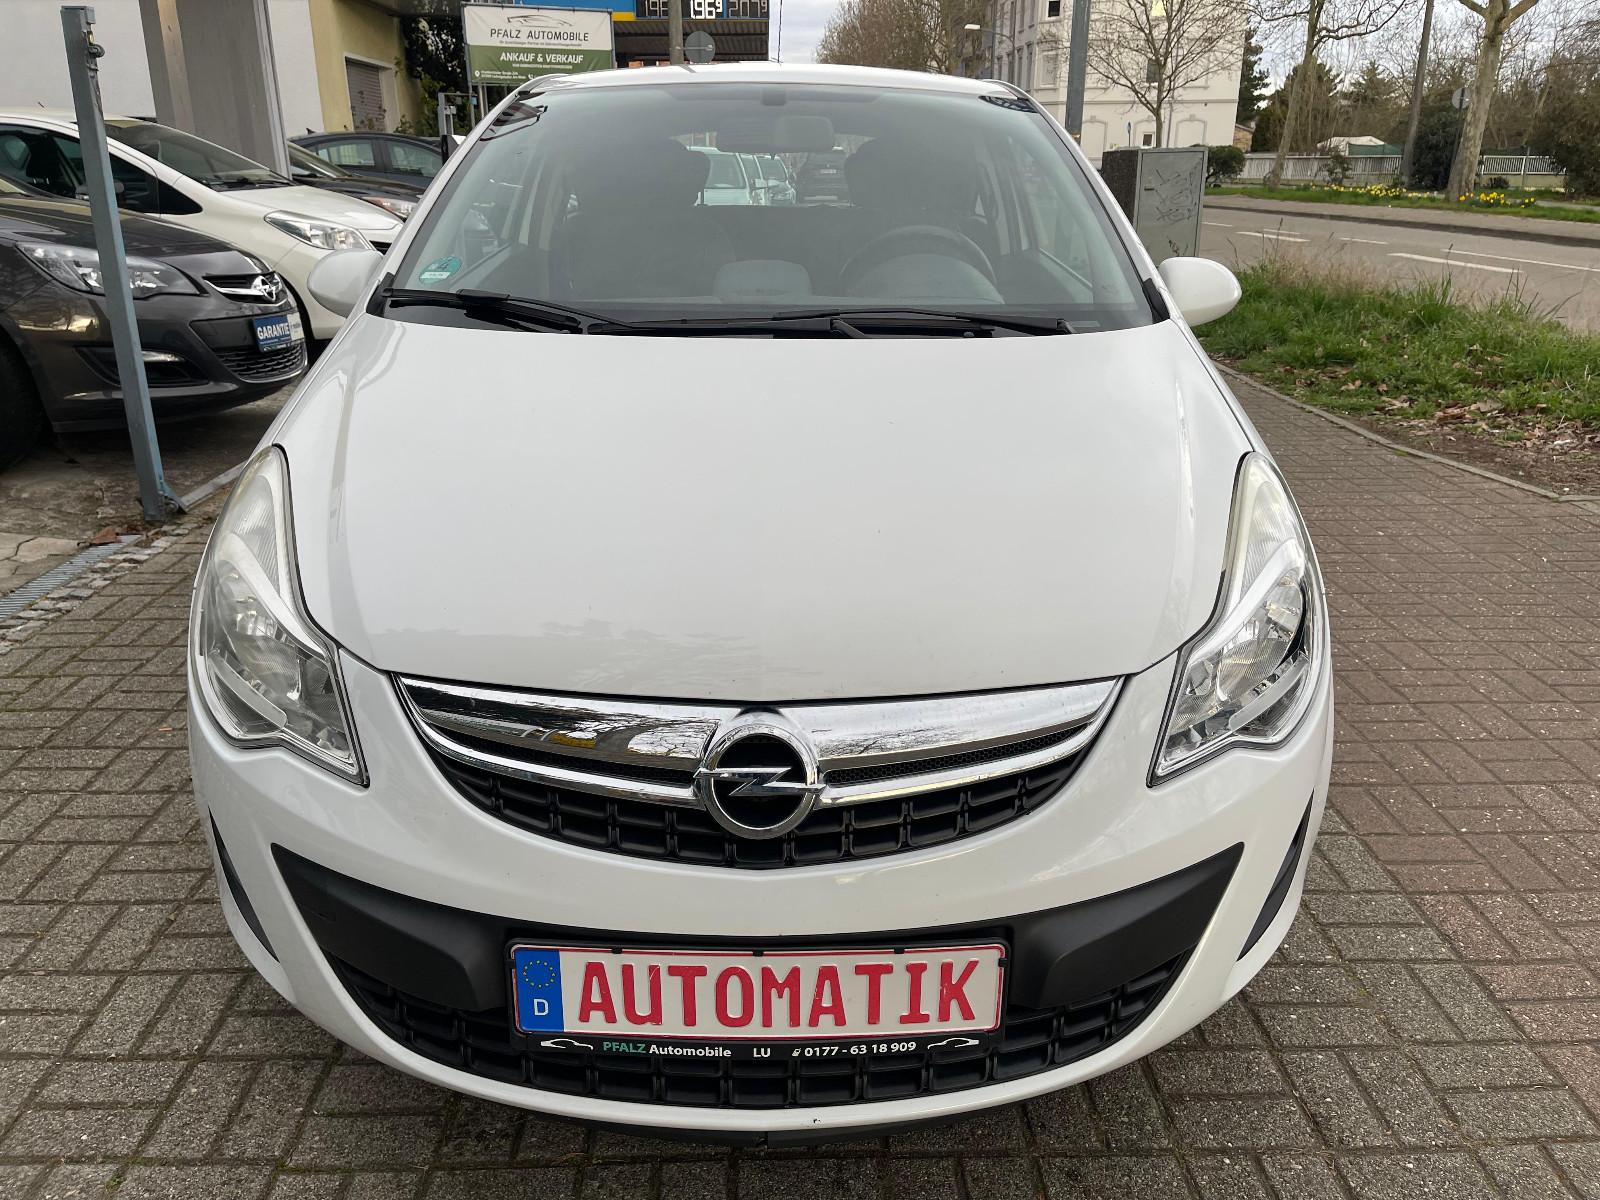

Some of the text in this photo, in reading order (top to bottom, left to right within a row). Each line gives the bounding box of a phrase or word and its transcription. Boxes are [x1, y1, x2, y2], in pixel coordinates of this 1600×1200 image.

[490, 28, 590, 42] PFALZ AUTOMOBILE
[500, 52, 584, 64] ANKAUF & VERKAUF
[257, 322, 290, 340] GARANTIE
[533, 960, 980, 1028] D AUTOMATIK
[603, 1041, 646, 1054] PFALZ
[649, 1043, 732, 1057] Automobile
[753, 1047, 771, 1058] LU
[804, 1046, 839, 1057] 0177
[850, 1045, 867, 1055] 63
[872, 1043, 888, 1054] 18
[890, 1041, 917, 1053] 909
